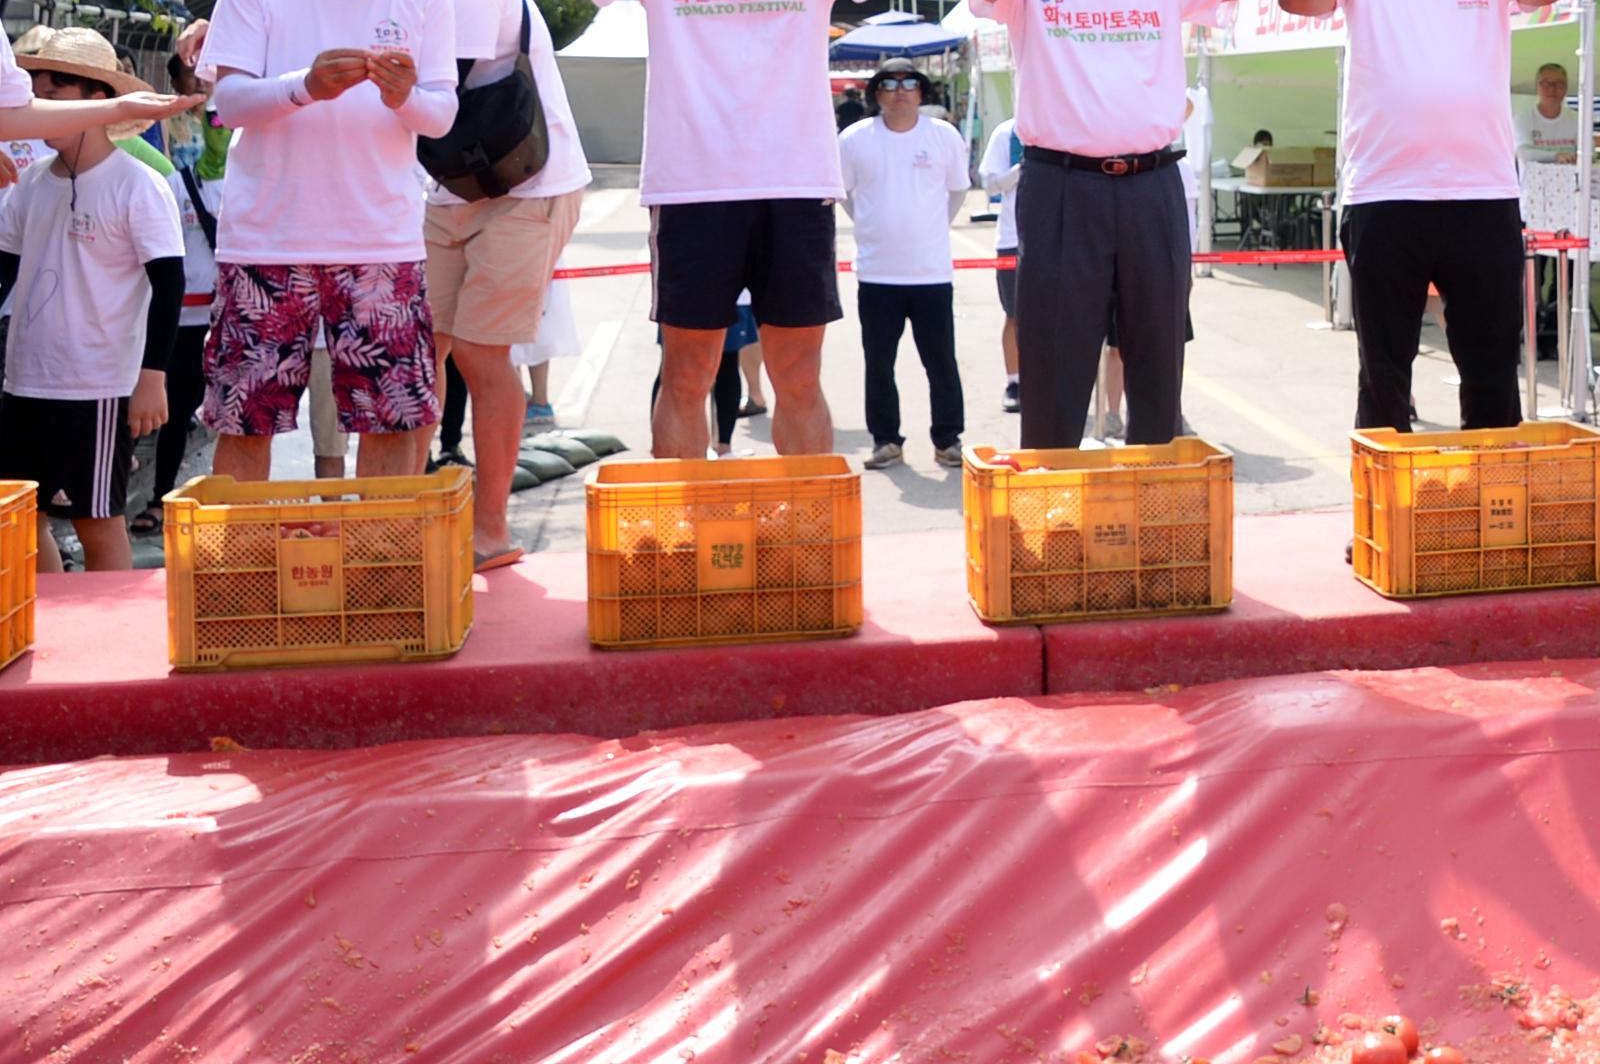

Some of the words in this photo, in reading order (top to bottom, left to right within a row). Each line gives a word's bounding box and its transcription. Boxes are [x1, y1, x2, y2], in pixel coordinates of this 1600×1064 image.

[674, 3, 735, 16] TOMATO
[739, 0, 806, 14] FESTIVAL
[291, 564, 333, 580] 한농원
